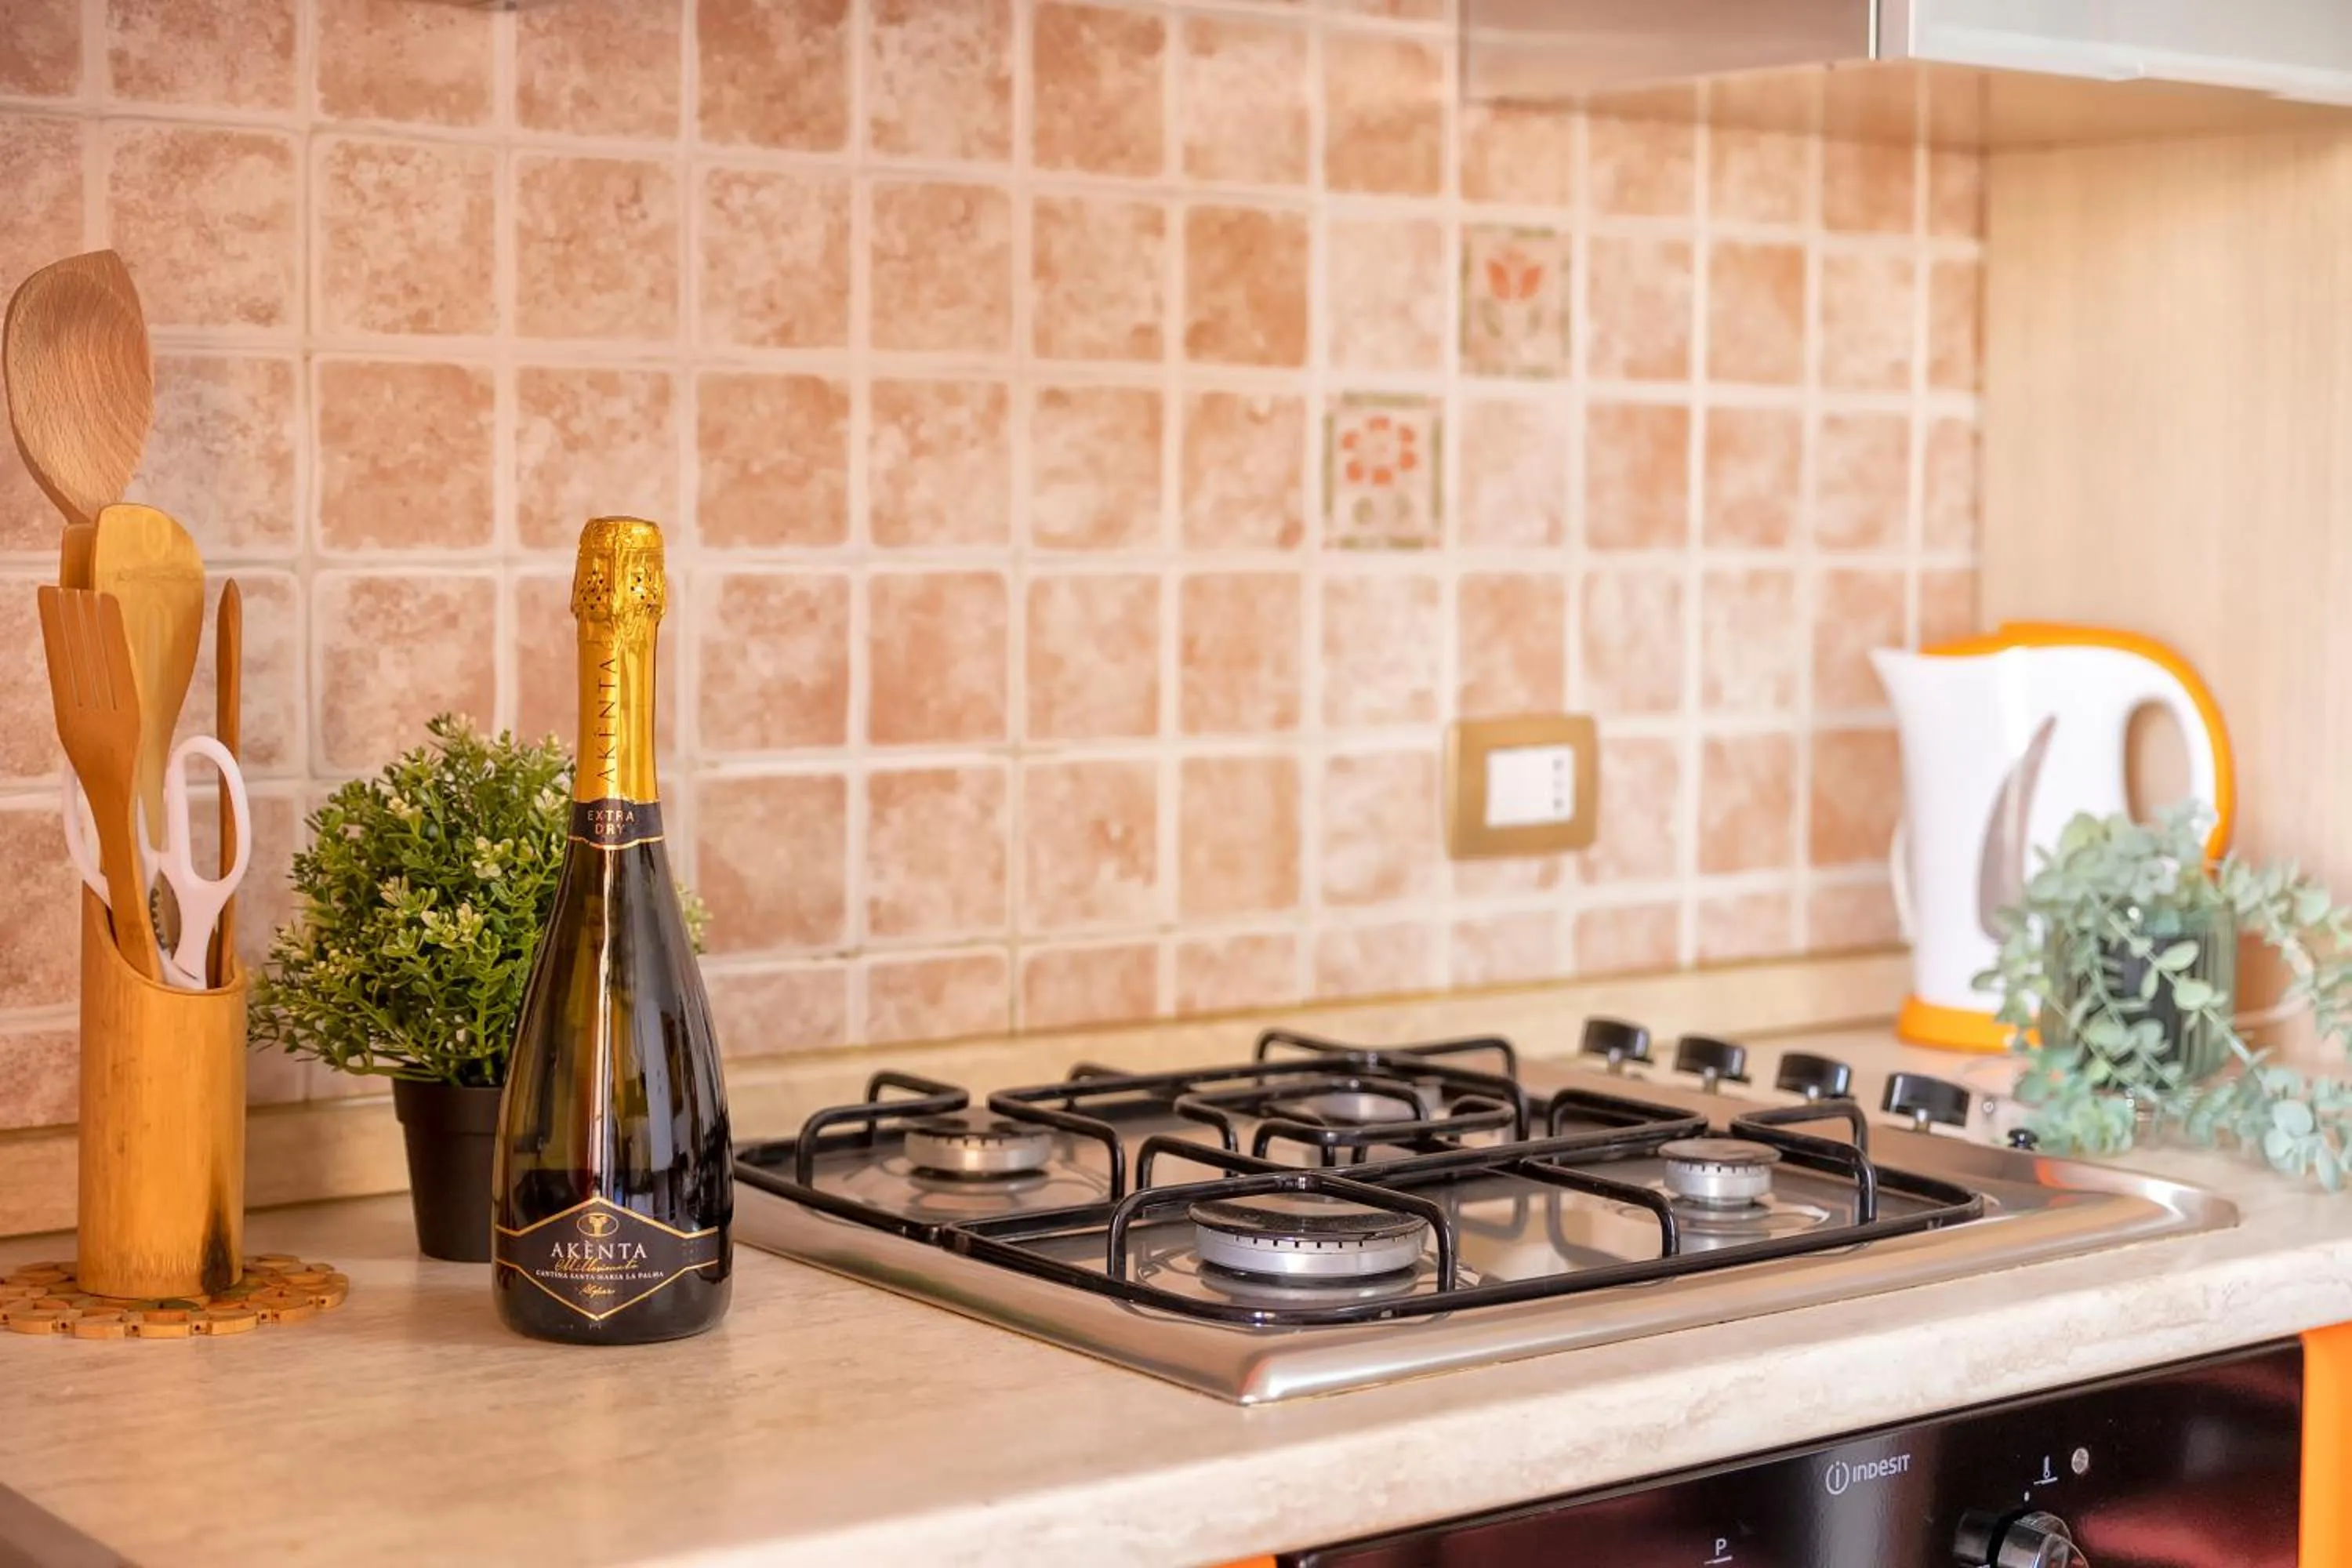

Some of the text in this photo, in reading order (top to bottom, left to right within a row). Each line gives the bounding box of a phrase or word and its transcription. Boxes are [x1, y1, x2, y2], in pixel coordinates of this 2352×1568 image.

[587, 809, 635, 822] EXTRA
[595, 823, 626, 835] DRY
[1716, 1538, 1727, 1555] P
